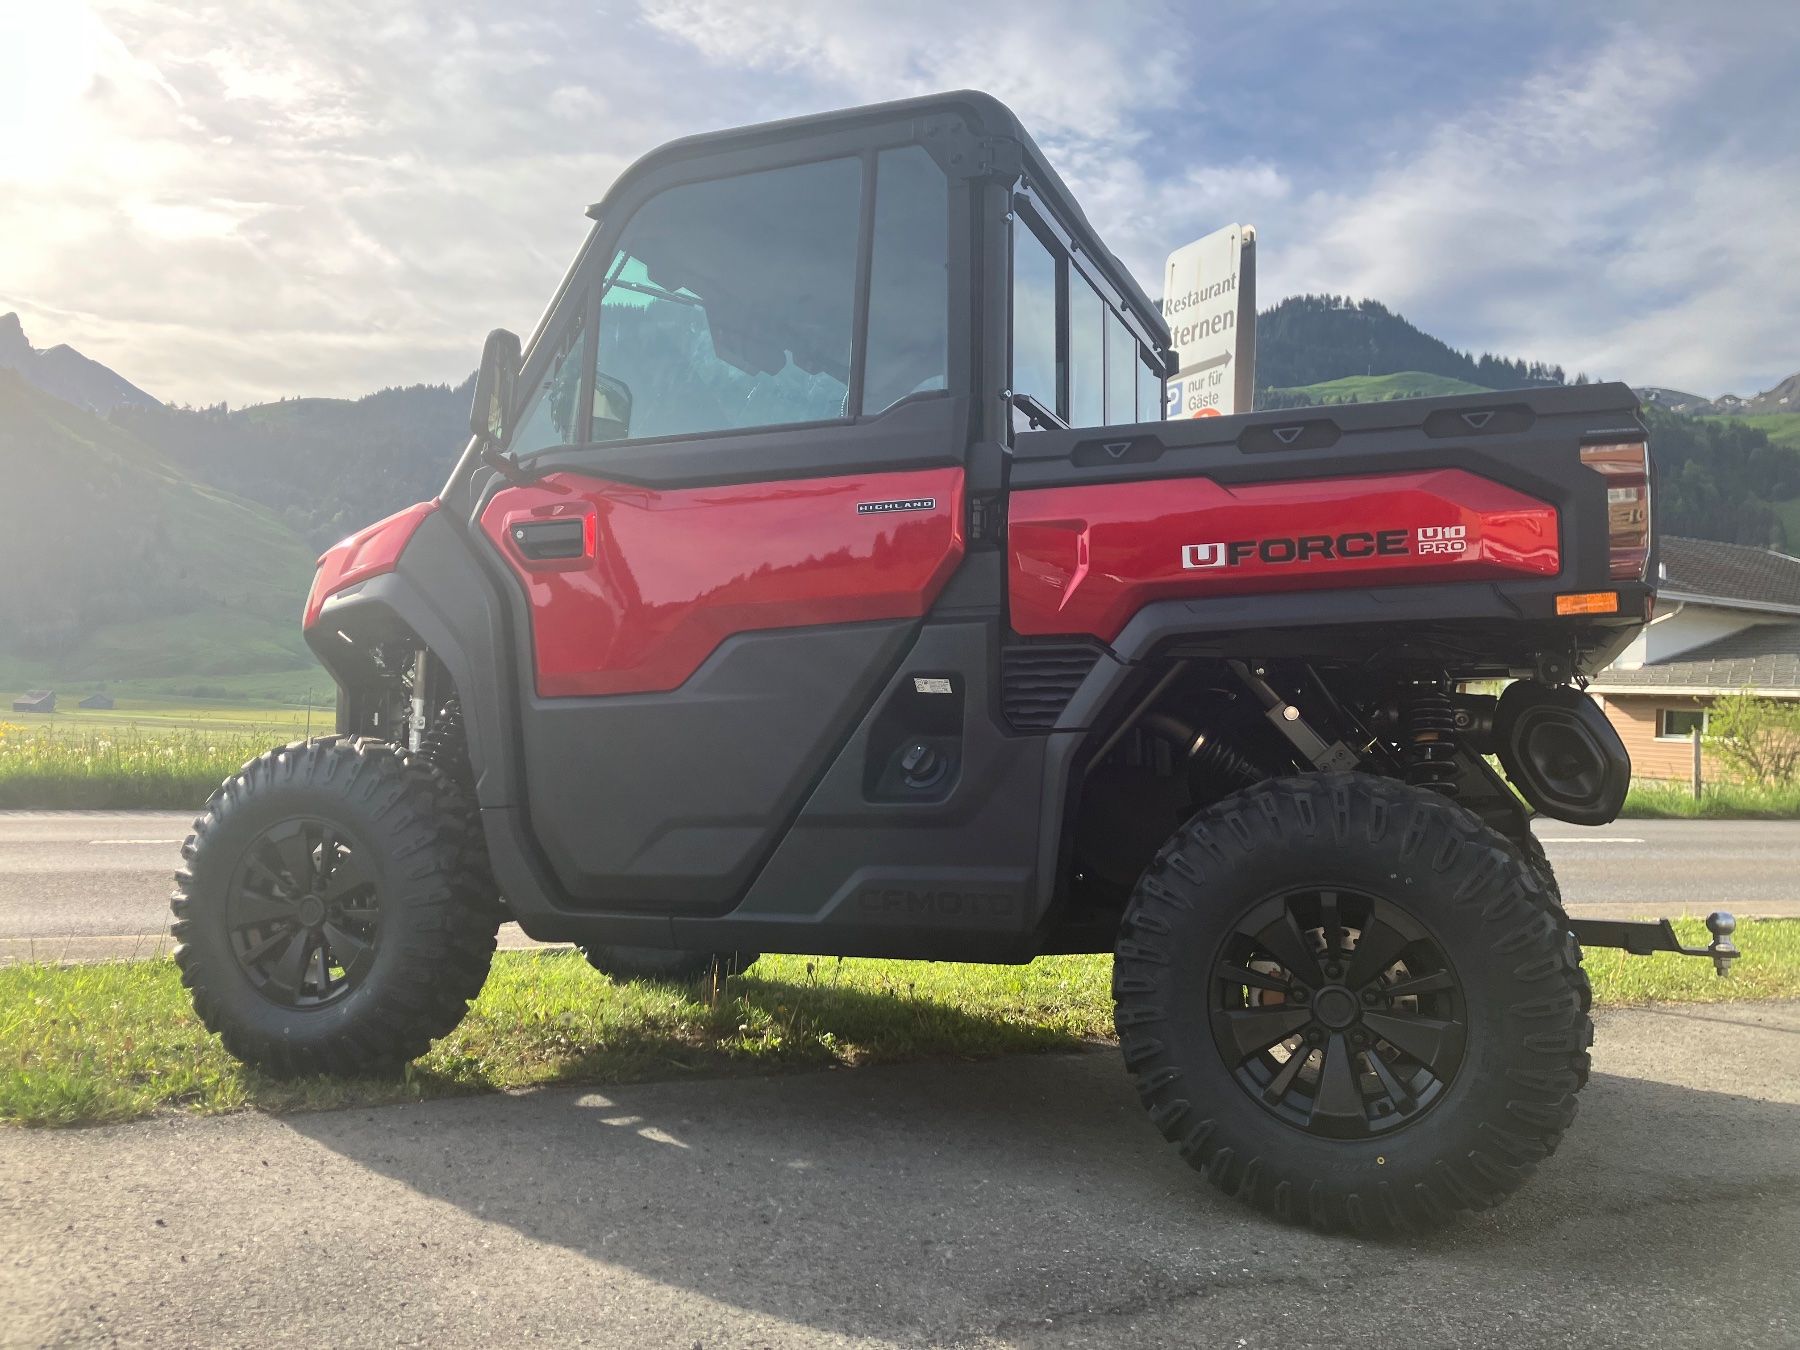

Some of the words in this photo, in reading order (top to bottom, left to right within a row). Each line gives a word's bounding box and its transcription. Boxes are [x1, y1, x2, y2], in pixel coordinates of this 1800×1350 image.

[1164, 272, 1236, 317] Restaurant
[1169, 309, 1234, 348] ternen
[1188, 377, 1205, 393] nur
[1208, 370, 1223, 387] für
[1188, 392, 1219, 411] Gäste
[859, 501, 932, 511] HIGHLAND
[1418, 526, 1466, 541] U10
[1418, 540, 1467, 555] PRO
